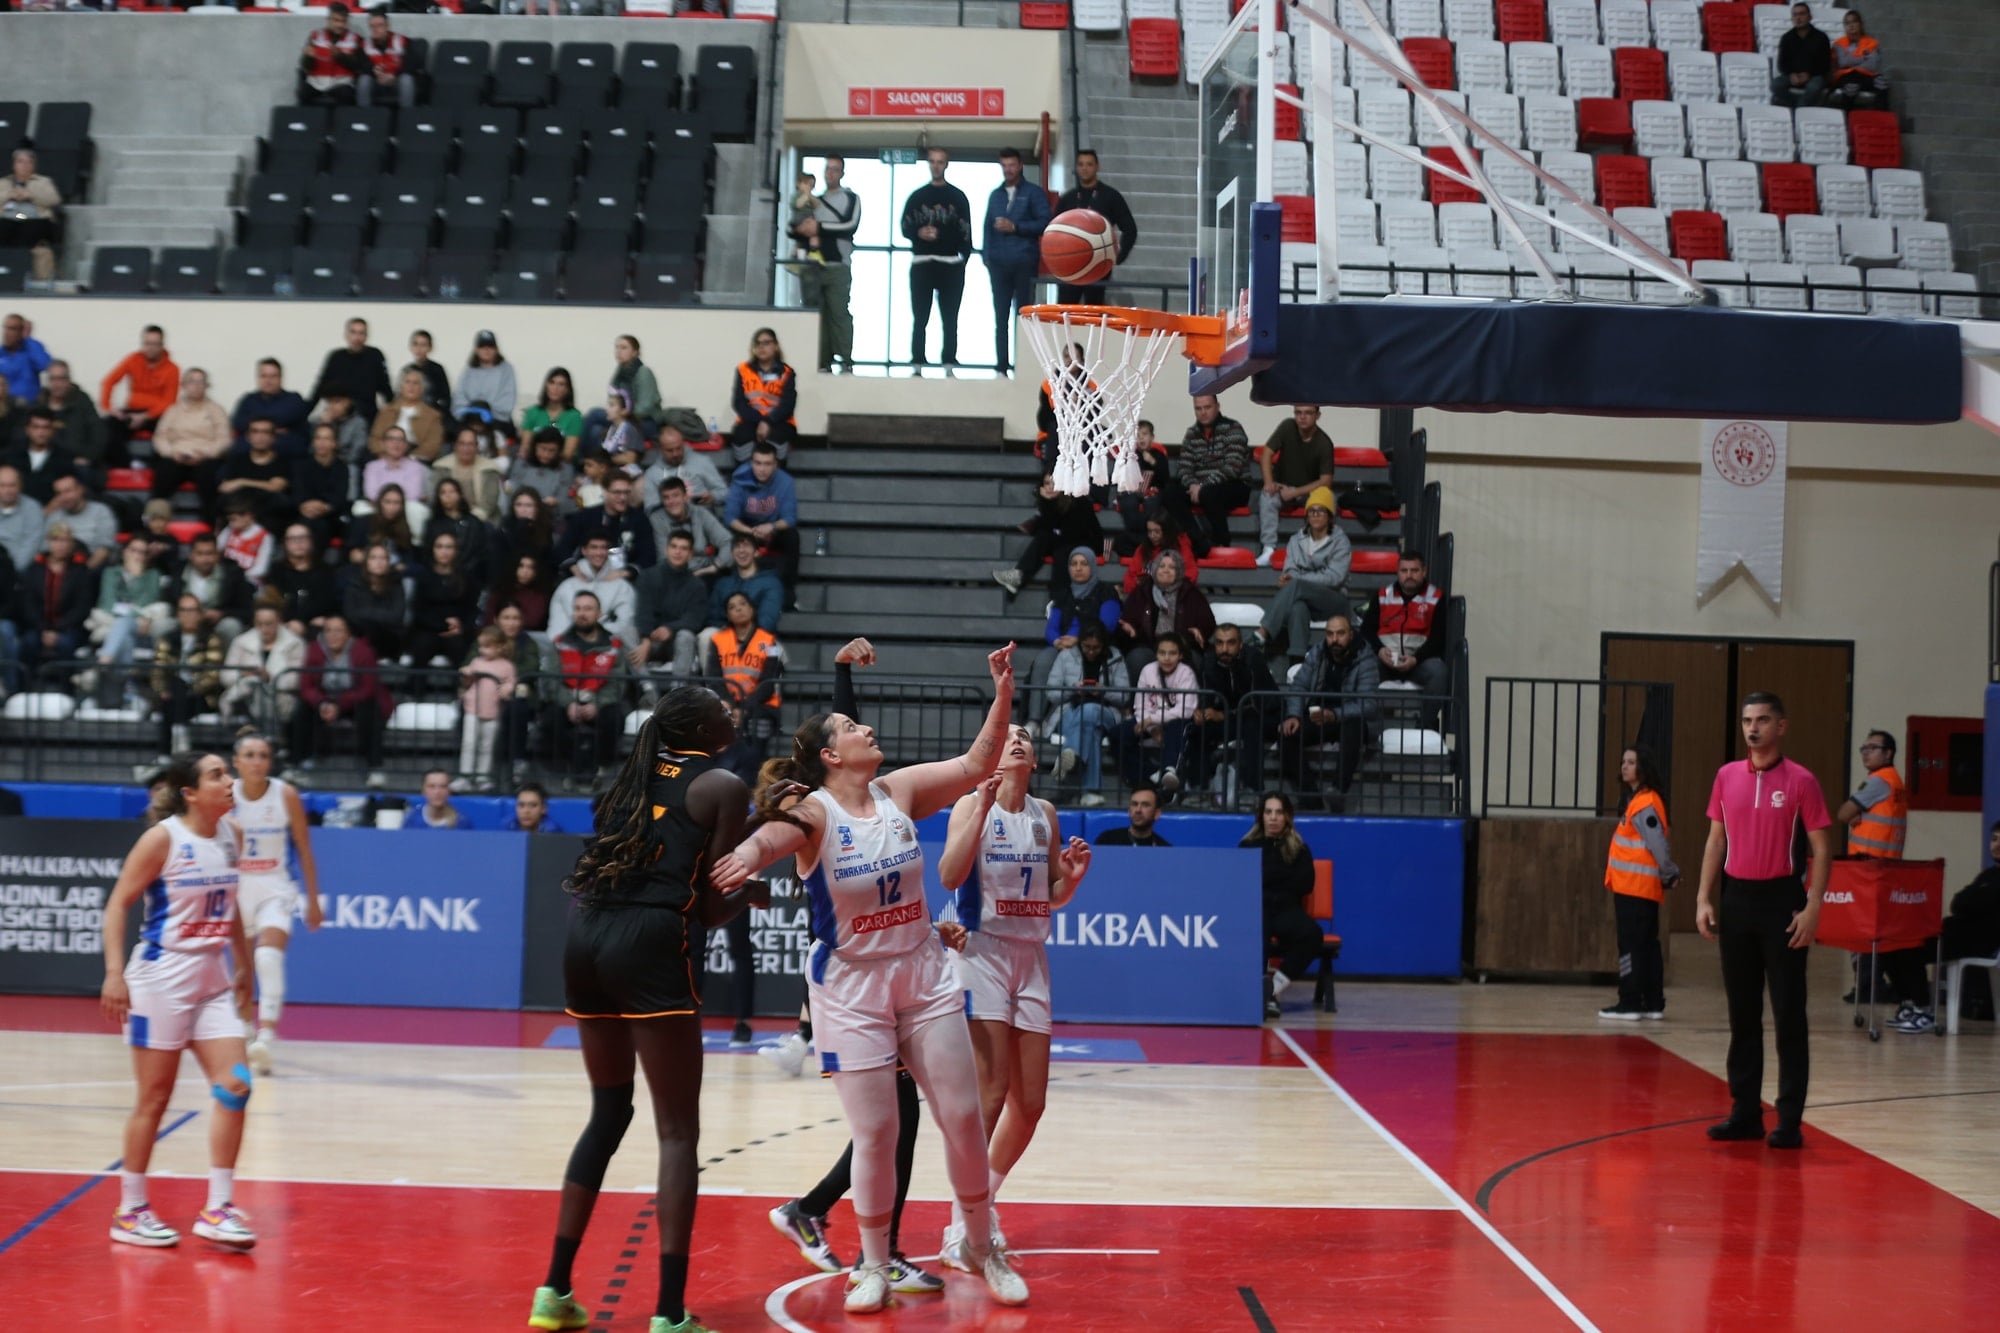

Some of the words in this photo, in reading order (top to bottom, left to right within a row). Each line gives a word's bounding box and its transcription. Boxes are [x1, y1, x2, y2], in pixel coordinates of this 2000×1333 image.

[887, 91, 931, 105] SALON
[933, 92, 966, 108] ÇIKIŞ
[246, 839, 257, 857] 2
[0, 855, 120, 877] HALKBANK
[833, 861, 879, 881] ÇANAKKALE
[876, 870, 902, 907] 12
[1021, 867, 1033, 897] 7
[0, 884, 103, 908] DINLAR
[205, 889, 226, 918] 10
[0, 907, 102, 930] SKETBO
[749, 906, 810, 928] INLA
[1045, 912, 1219, 949] LKBANK
